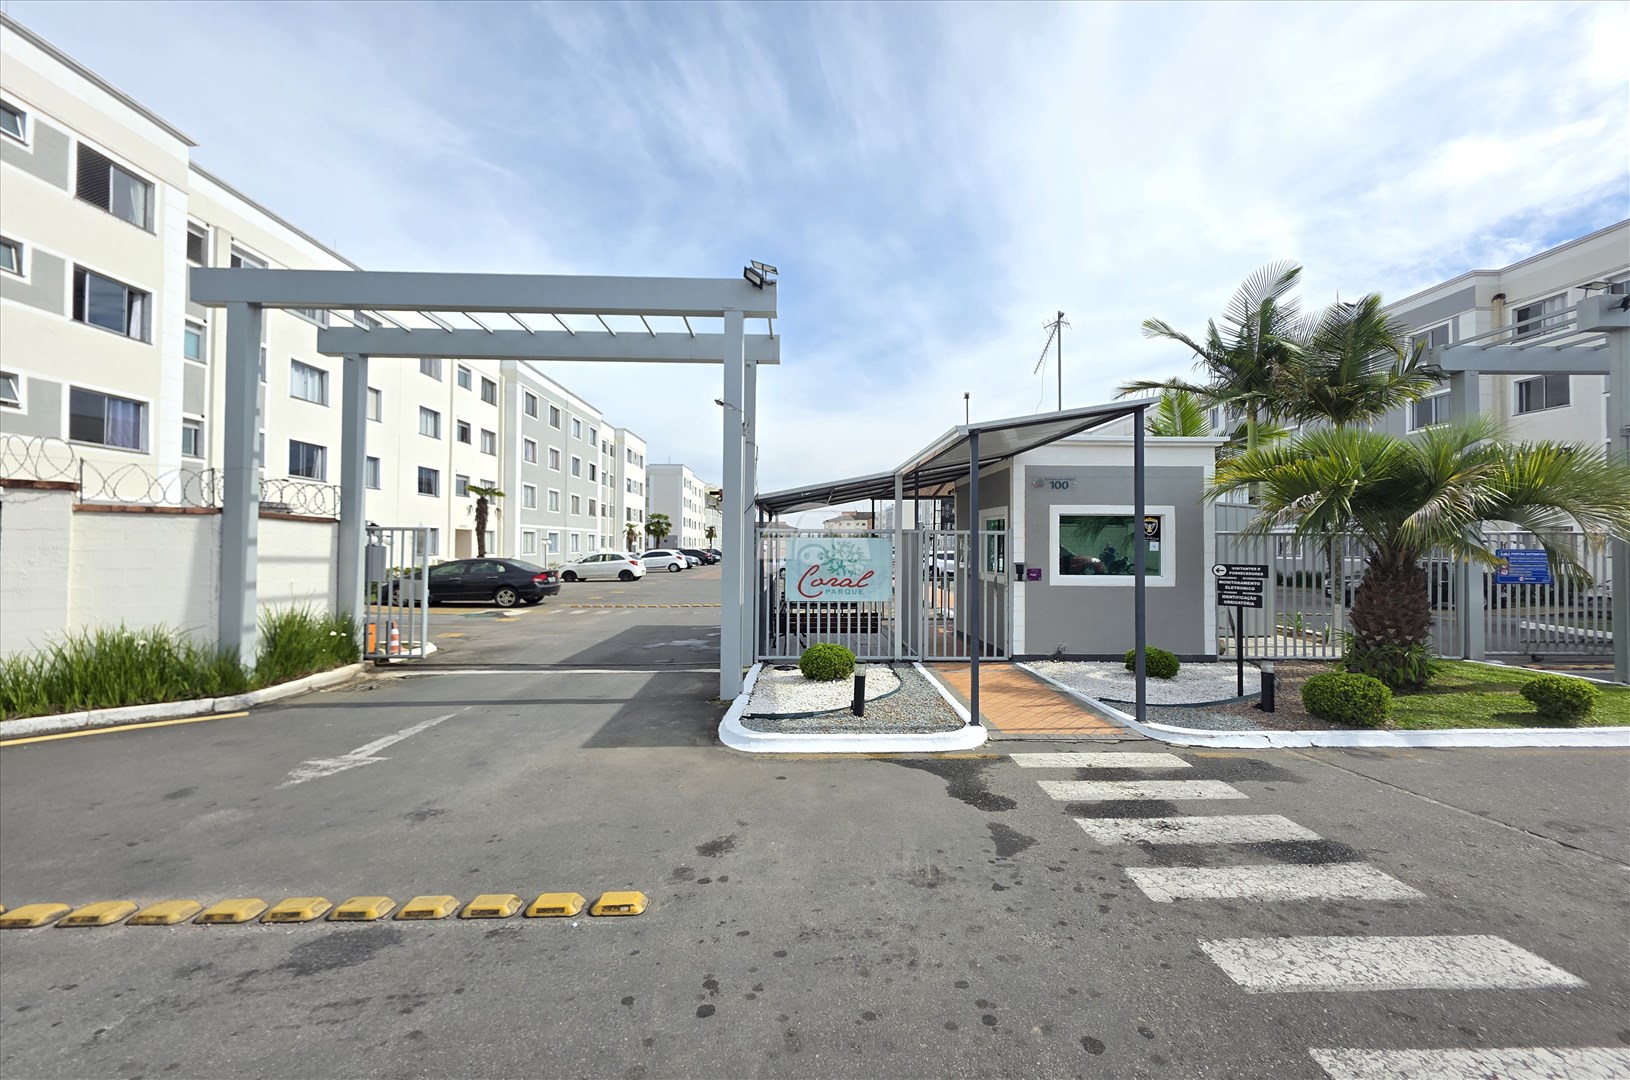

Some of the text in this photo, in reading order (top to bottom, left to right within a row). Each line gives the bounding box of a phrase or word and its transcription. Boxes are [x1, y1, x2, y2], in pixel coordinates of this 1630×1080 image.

[1050, 481, 1069, 489] 100
[798, 564, 875, 598] Coral
[825, 588, 864, 596] PARQUE
